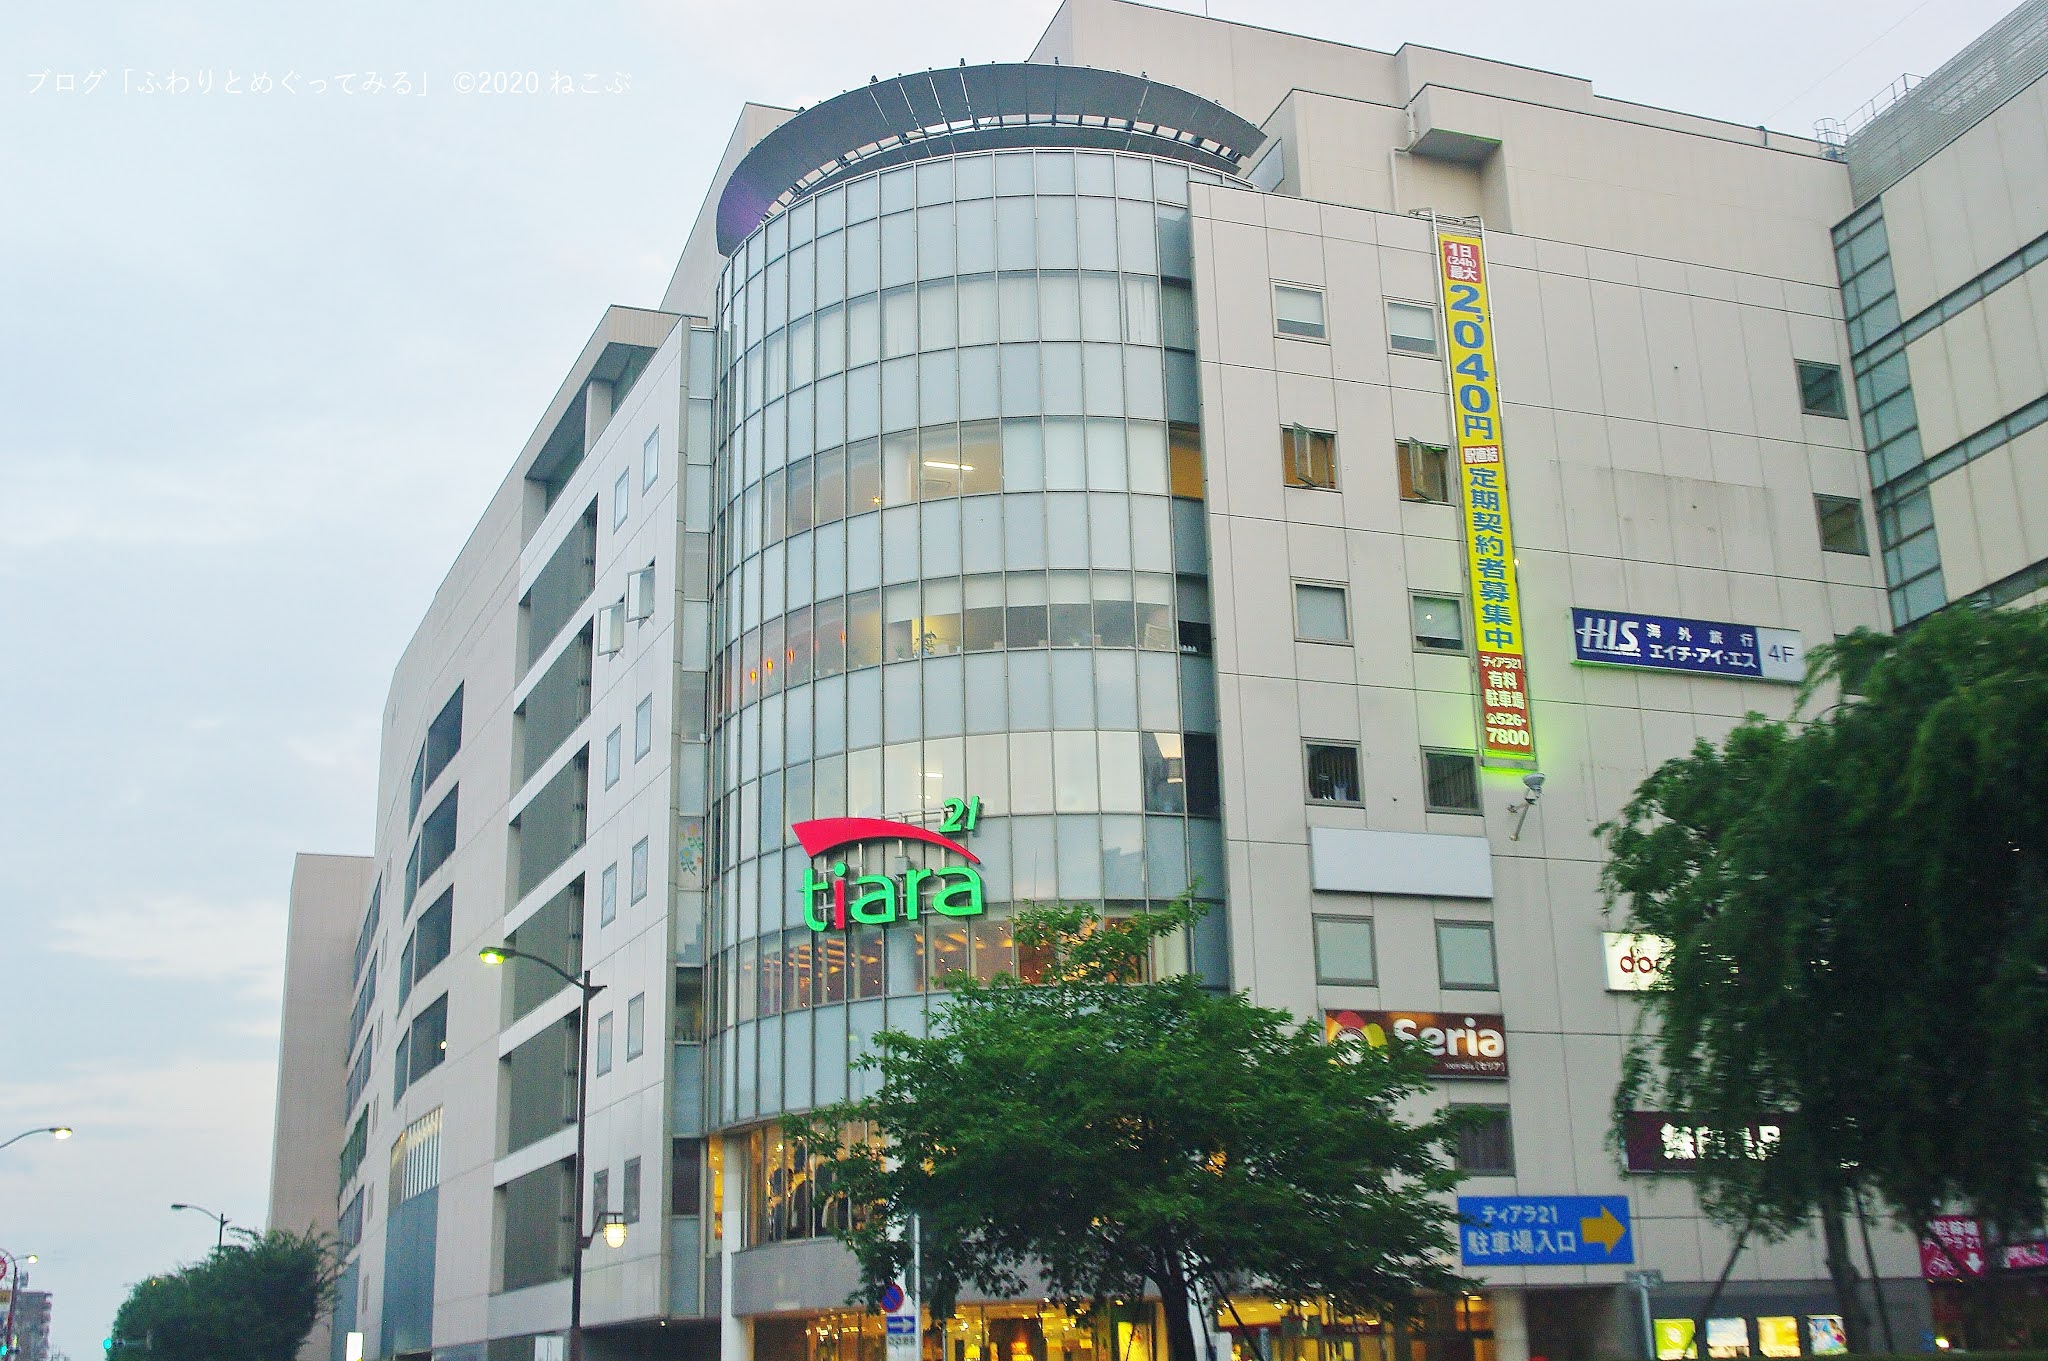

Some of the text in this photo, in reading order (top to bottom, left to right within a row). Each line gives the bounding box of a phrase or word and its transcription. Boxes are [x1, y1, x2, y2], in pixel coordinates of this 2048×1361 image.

[1448, 243, 1472, 259] 1日
[1447, 255, 1477, 269] (24h)
[1450, 265, 1478, 281] 最大
[1449, 284, 1494, 440] 2,040円
[1465, 447, 1498, 463] 駅直結
[1468, 467, 1514, 650] 定期契約者募集中
[1646, 623, 1754, 649] 海外旅行
[1481, 655, 1522, 670] ティアラ21
[1768, 644, 1795, 663] 4F
[1487, 670, 1518, 690] 有料
[1485, 688, 1525, 710] 駐車場
[1486, 726, 1530, 746] 7800
[939, 795, 980, 833] 21
[797, 861, 983, 932] tiara
[1393, 1017, 1505, 1058] Seria
[1482, 1205, 1559, 1225] ティアラ21
[1467, 1229, 1577, 1256] 駐車場入口
